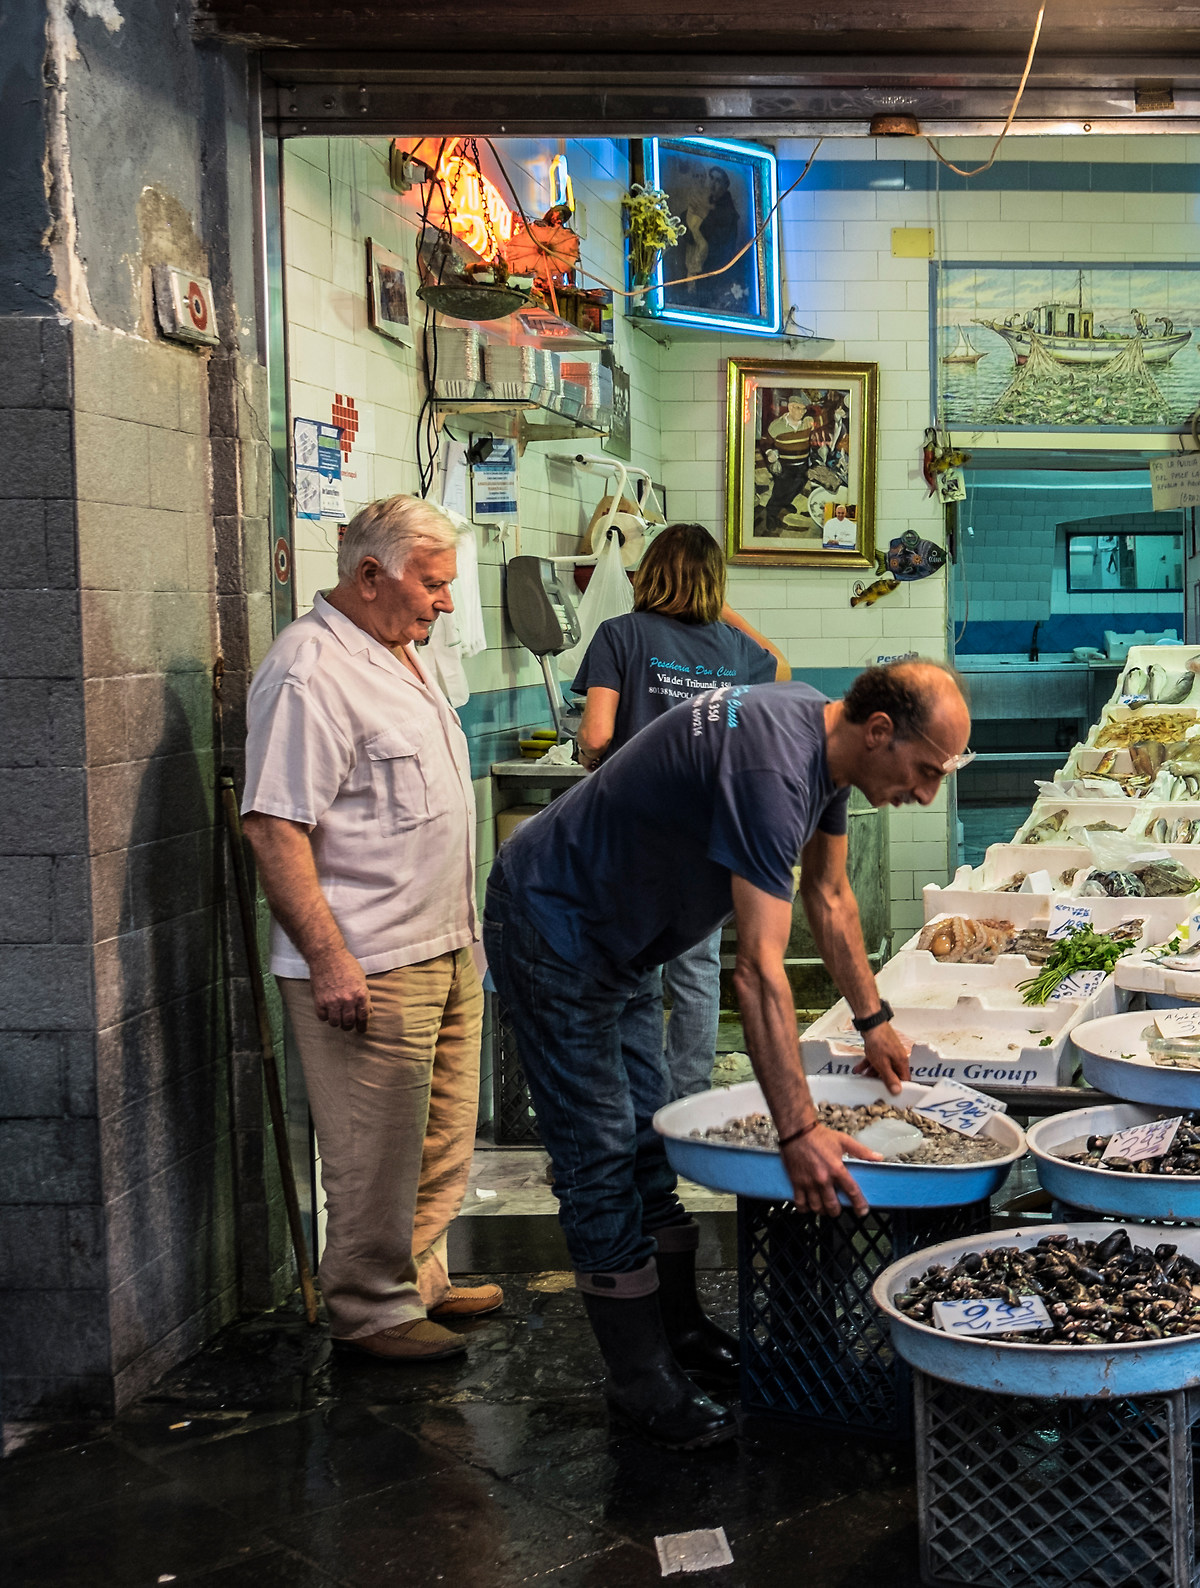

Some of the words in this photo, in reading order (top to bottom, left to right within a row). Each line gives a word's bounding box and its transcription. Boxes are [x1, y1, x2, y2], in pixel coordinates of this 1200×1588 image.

[650, 657, 690, 673] Pescheria
[695, 665, 712, 675] Don
[657, 673, 671, 683] Via
[671, 675, 683, 686] dei
[707, 703, 720, 721] 350
[818, 1061, 954, 1077] Aneda
[964, 1064, 1038, 1084] Group
